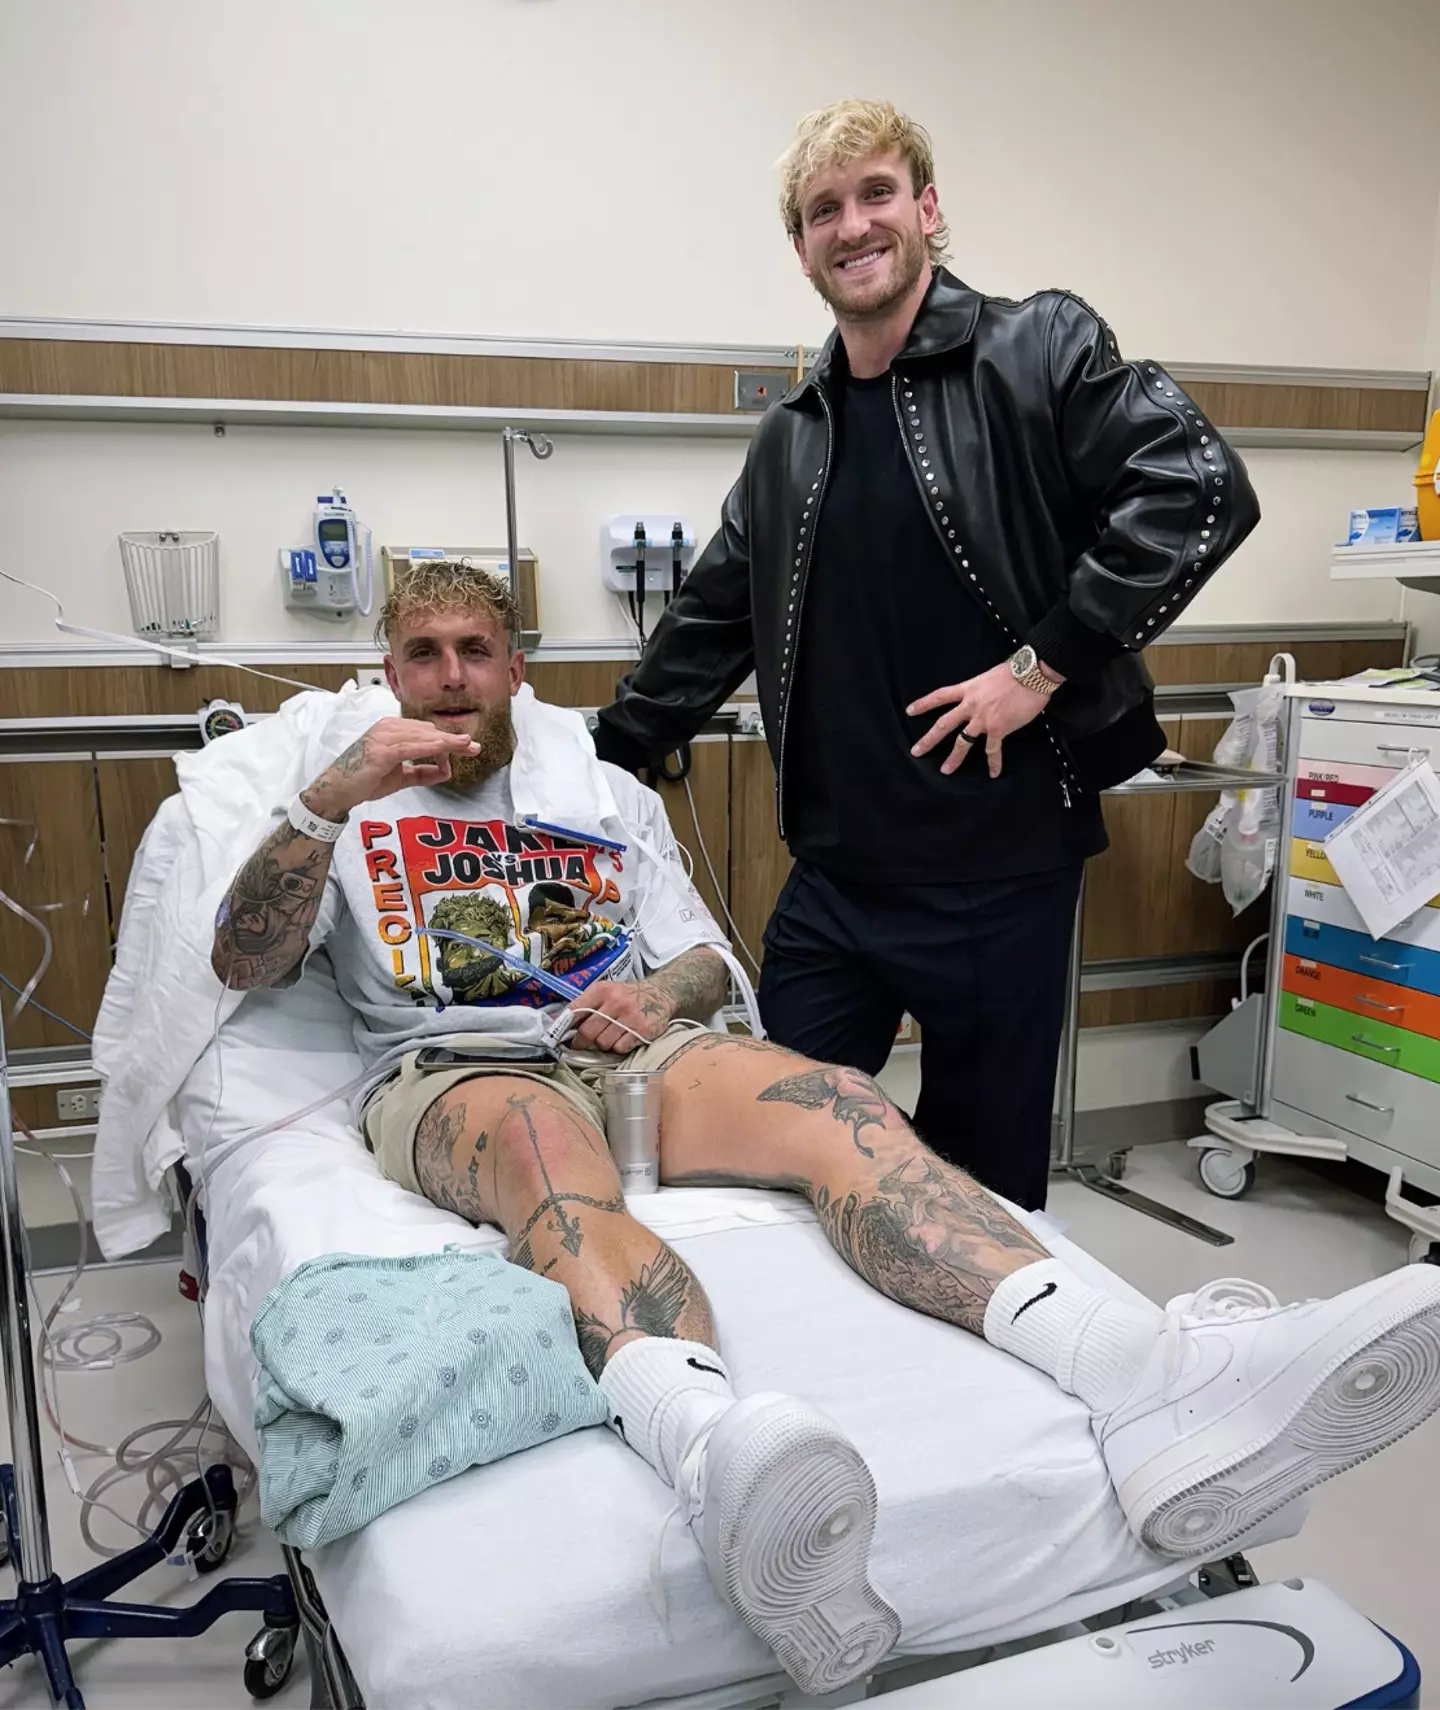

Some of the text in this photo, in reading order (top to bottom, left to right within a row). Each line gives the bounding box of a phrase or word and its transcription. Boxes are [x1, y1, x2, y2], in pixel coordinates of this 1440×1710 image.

[1308, 809, 1334, 821] PURPLE
[1306, 848, 1329, 862] YELLO
[424, 852, 591, 886] JOSHUA
[1304, 889, 1324, 902] WHITE
[1295, 965, 1322, 981] ORANGE
[1295, 1003, 1316, 1017] GREEN
[1147, 1638, 1216, 1669] stryker
